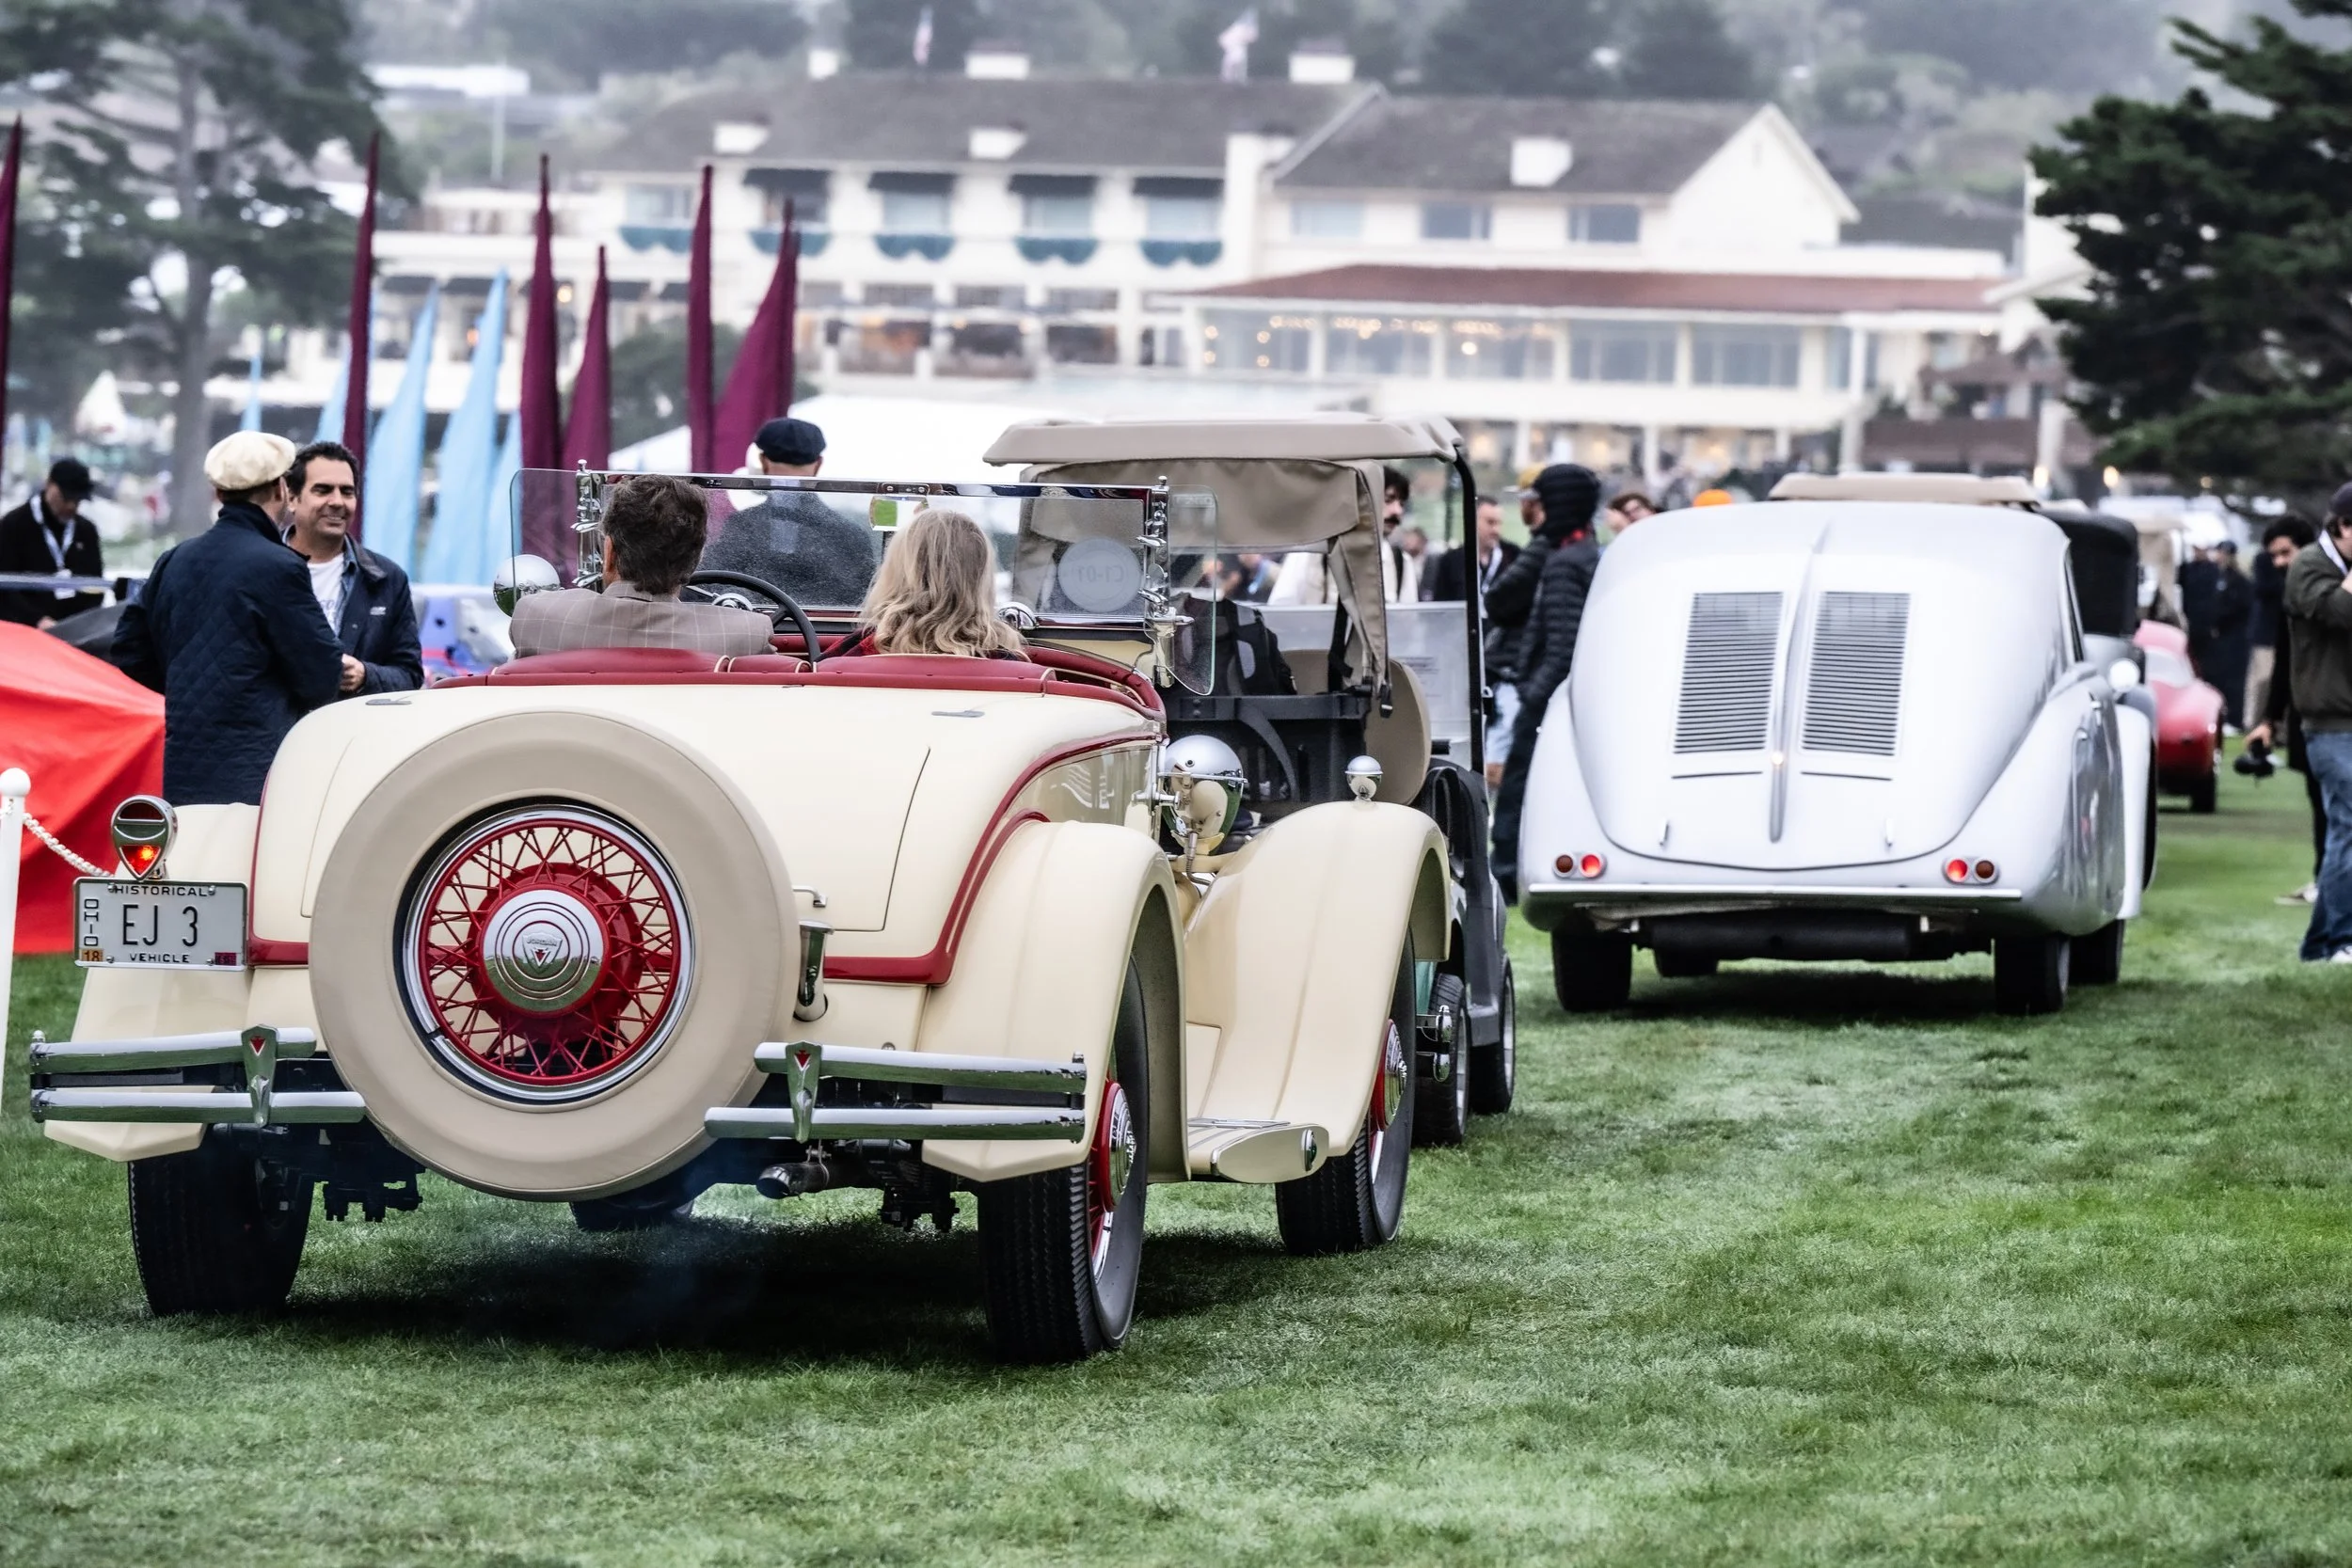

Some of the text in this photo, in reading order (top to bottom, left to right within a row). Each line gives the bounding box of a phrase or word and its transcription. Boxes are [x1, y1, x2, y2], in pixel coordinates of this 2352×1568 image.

[114, 885, 208, 897] HISTORICAL
[83, 898, 99, 947] OHIO
[122, 903, 199, 947] EJ 3
[84, 950, 101, 961] 18
[129, 953, 190, 963] VEHICLE
